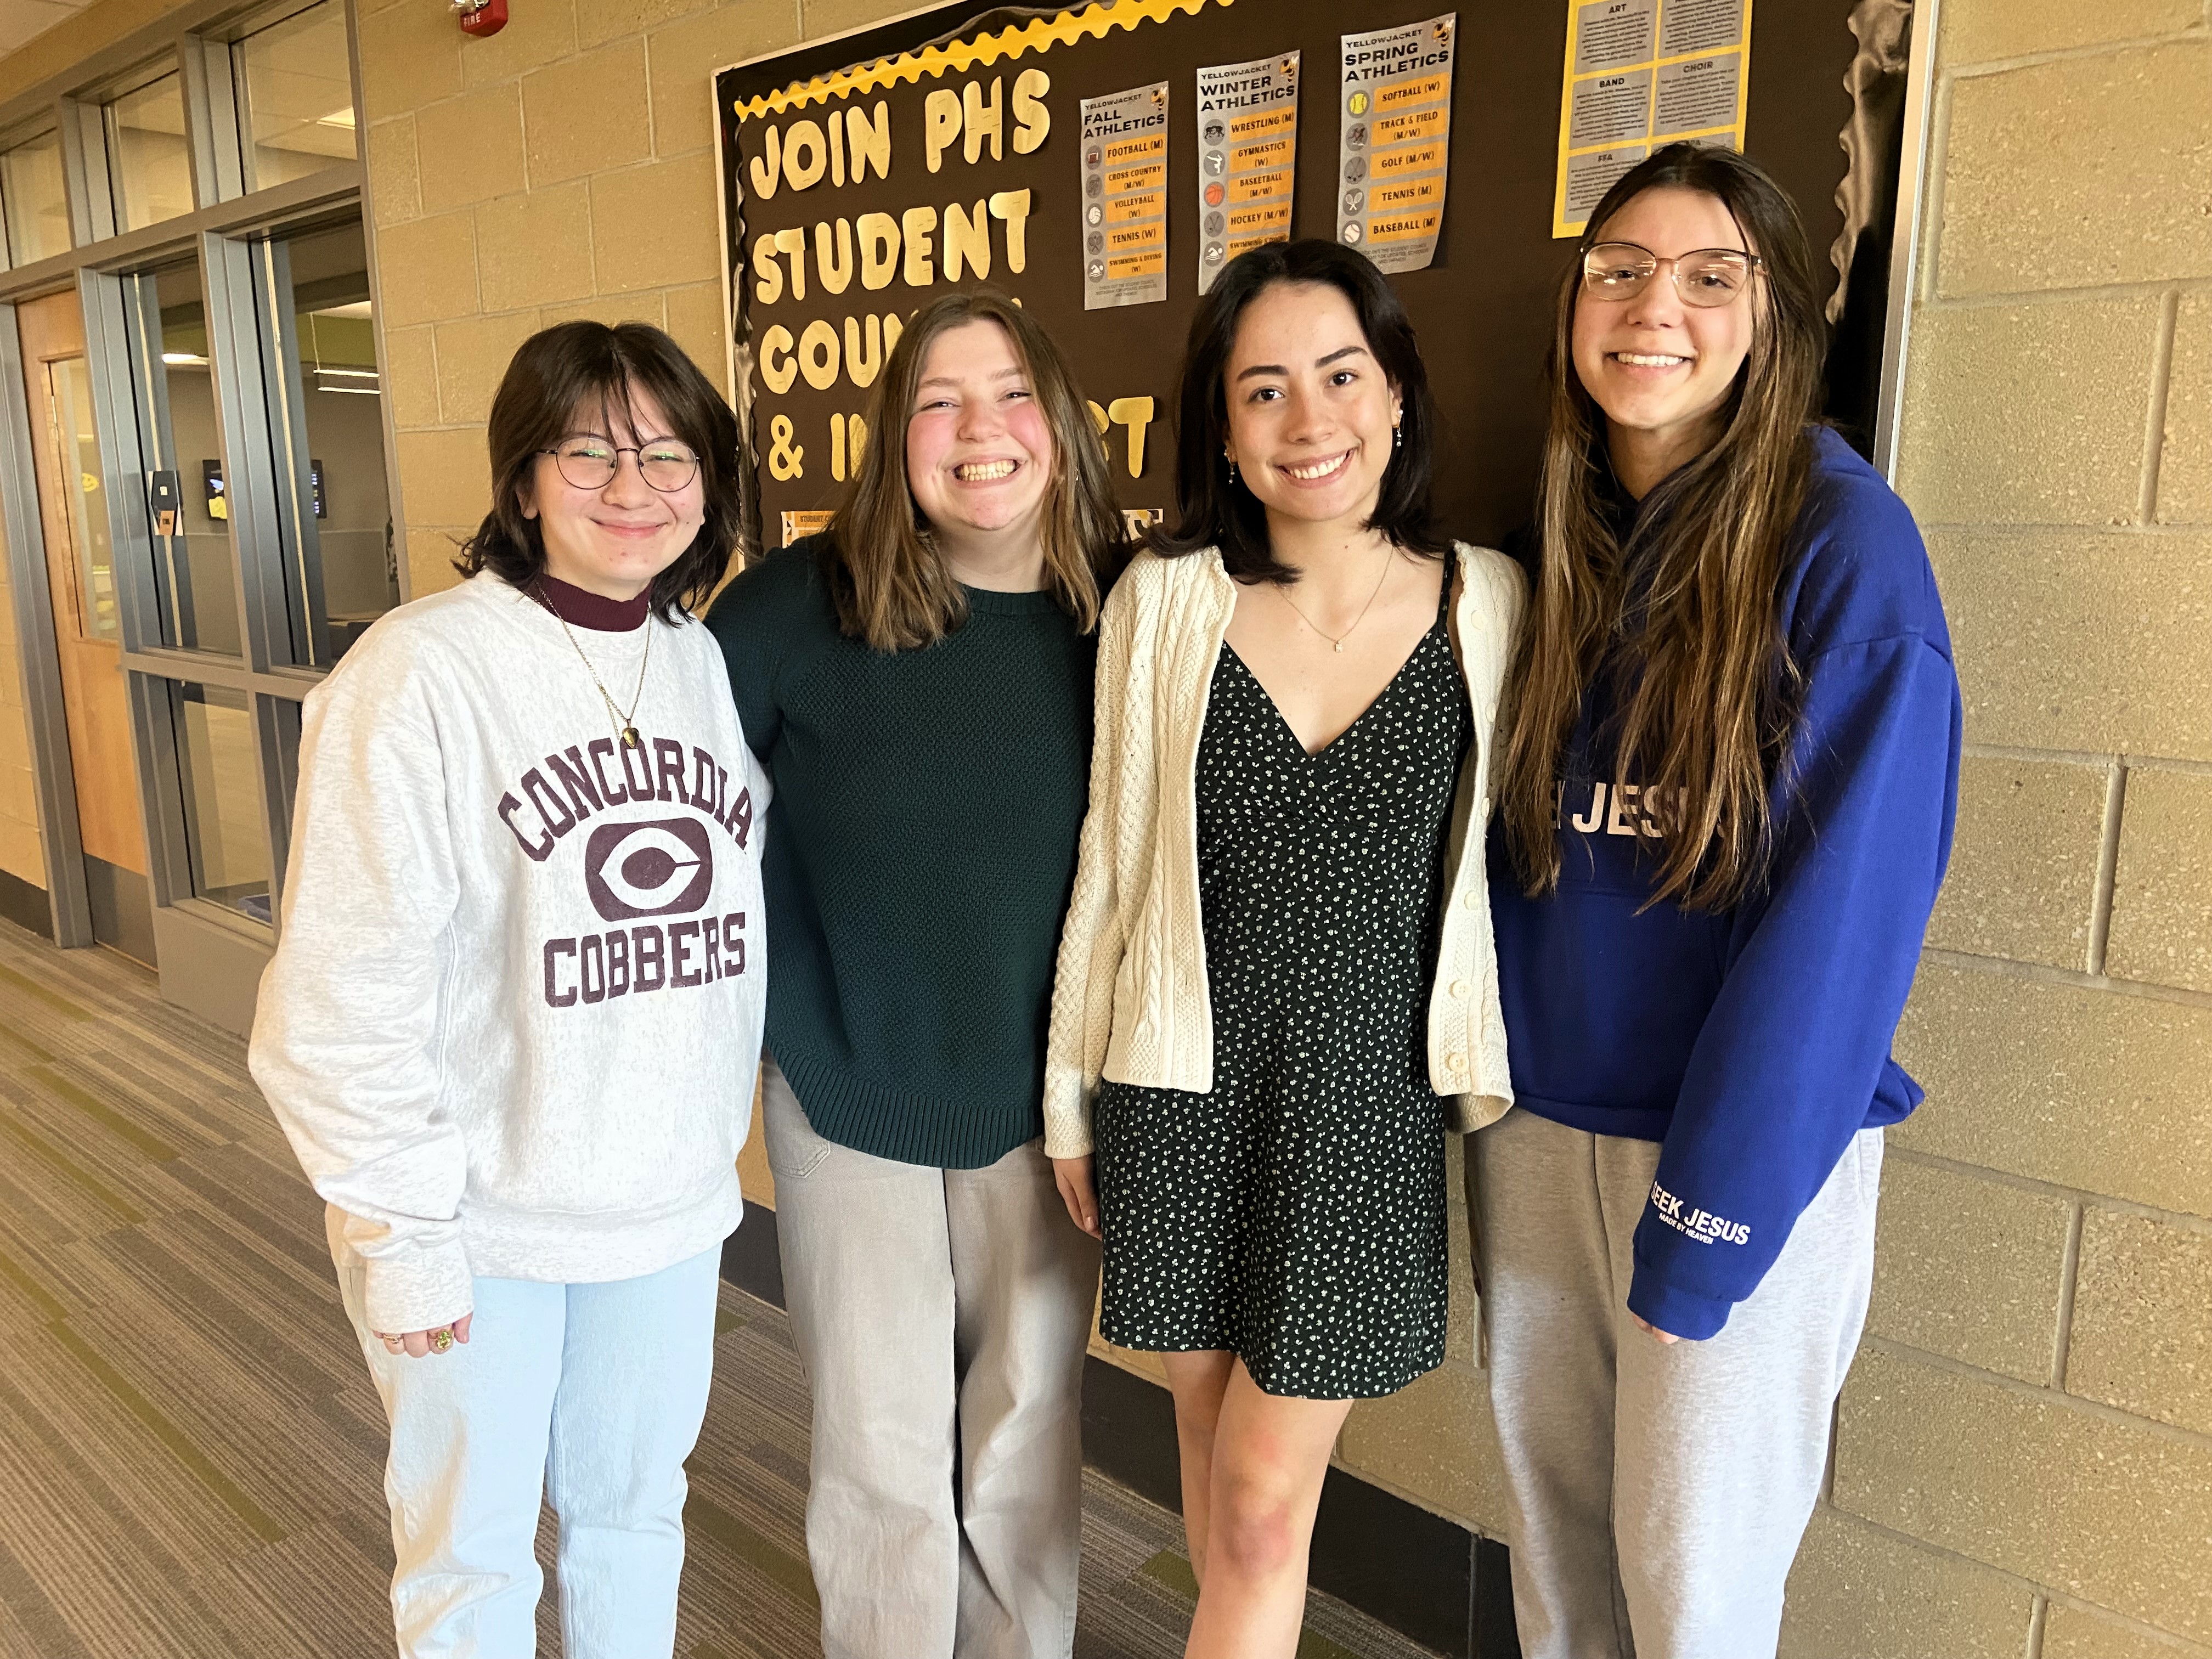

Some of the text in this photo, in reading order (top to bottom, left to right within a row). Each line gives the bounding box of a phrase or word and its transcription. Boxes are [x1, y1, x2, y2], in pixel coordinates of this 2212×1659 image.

[1609, 4, 1627, 14] ART
[1346, 29, 1423, 48] YELLOWJACKET
[1345, 42, 1418, 66] SPRING
[1201, 64, 1271, 80] YELLOWJACKET
[1345, 50, 1448, 82] ATHLETICS
[1683, 61, 1713, 73] CHOIR
[1200, 76, 1271, 96] WINTER
[1382, 81, 1440, 101] SOFTBALL (W)
[1599, 78, 1624, 88] BAND
[1085, 94, 1142, 110] YELLOWJACKET
[1201, 85, 1295, 112] ATHLETICS
[1085, 110, 1121, 125] FALL
[1232, 112, 1294, 133] WRESTLING (M)
[1380, 117, 1405, 129] TRACK
[1417, 111, 1438, 123] FIELD
[750, 69, 1051, 199] JOIN PHS
[1084, 114, 1165, 139] ATHLETICS
[1393, 127, 1420, 140] (M/W)
[1108, 139, 1163, 158] FOOTBALL (M)
[1238, 141, 1286, 157] GYMNASTICS
[1255, 157, 1268, 167] (W)
[1381, 151, 1435, 168] GOLF (M/W)
[1598, 154, 1613, 162] FFA
[1109, 165, 1161, 181] CROSS COUNTRY
[1240, 173, 1282, 187] BASKETBALL
[1124, 179, 1144, 190] (M/W)
[1250, 187, 1272, 198] (M/W)
[1382, 185, 1432, 201] TENNIS (M)
[1115, 195, 1154, 208] VOLLEYBALL
[1128, 210, 1141, 219] (W)
[1231, 208, 1288, 225] HOCKEY (M/W)
[1373, 217, 1435, 234] BASEBALL (M)
[1113, 228, 1156, 244] TENNIS (W)
[752, 188, 1030, 304] STUDENT
[1109, 257, 1138, 266] SWIMMING
[769, 414, 803, 481] &
[497, 737, 752, 862] CONCORDIA
[544, 912, 746, 1008] COBBERS
[1651, 1181, 1751, 1245] SEEK JESUS
[1659, 1212, 1714, 1245] MADE BY HEAVEN
